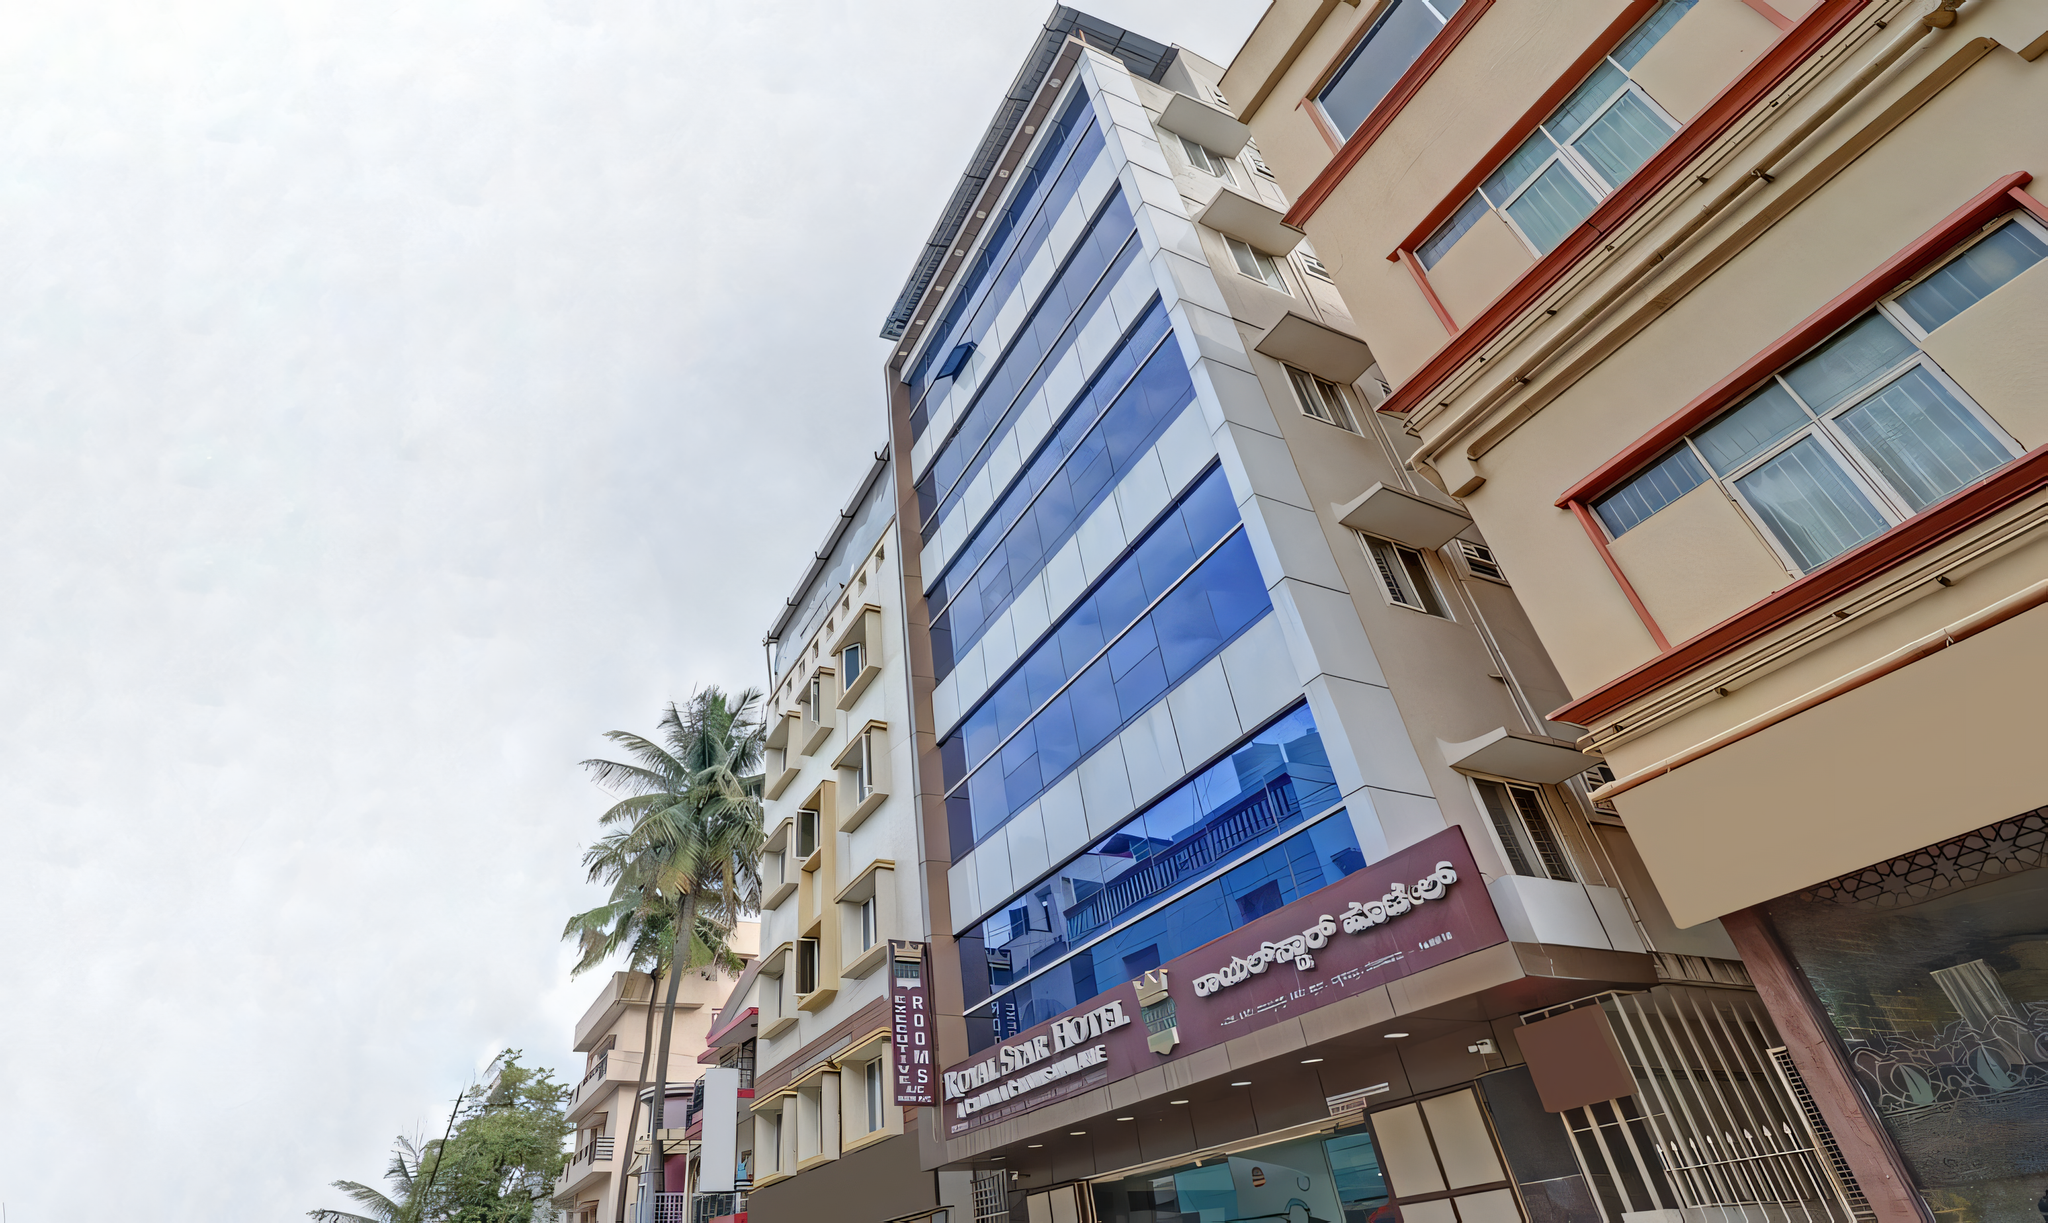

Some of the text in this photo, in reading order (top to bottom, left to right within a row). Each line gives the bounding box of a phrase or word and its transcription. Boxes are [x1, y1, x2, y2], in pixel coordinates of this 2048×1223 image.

[894, 995, 911, 1084] EXECUTIVE
[912, 996, 929, 1083] ROOMS
[943, 1056, 1000, 1101] ROYAL
[1000, 1035, 1050, 1076] STAR
[1050, 1000, 1131, 1054] HOTEL
